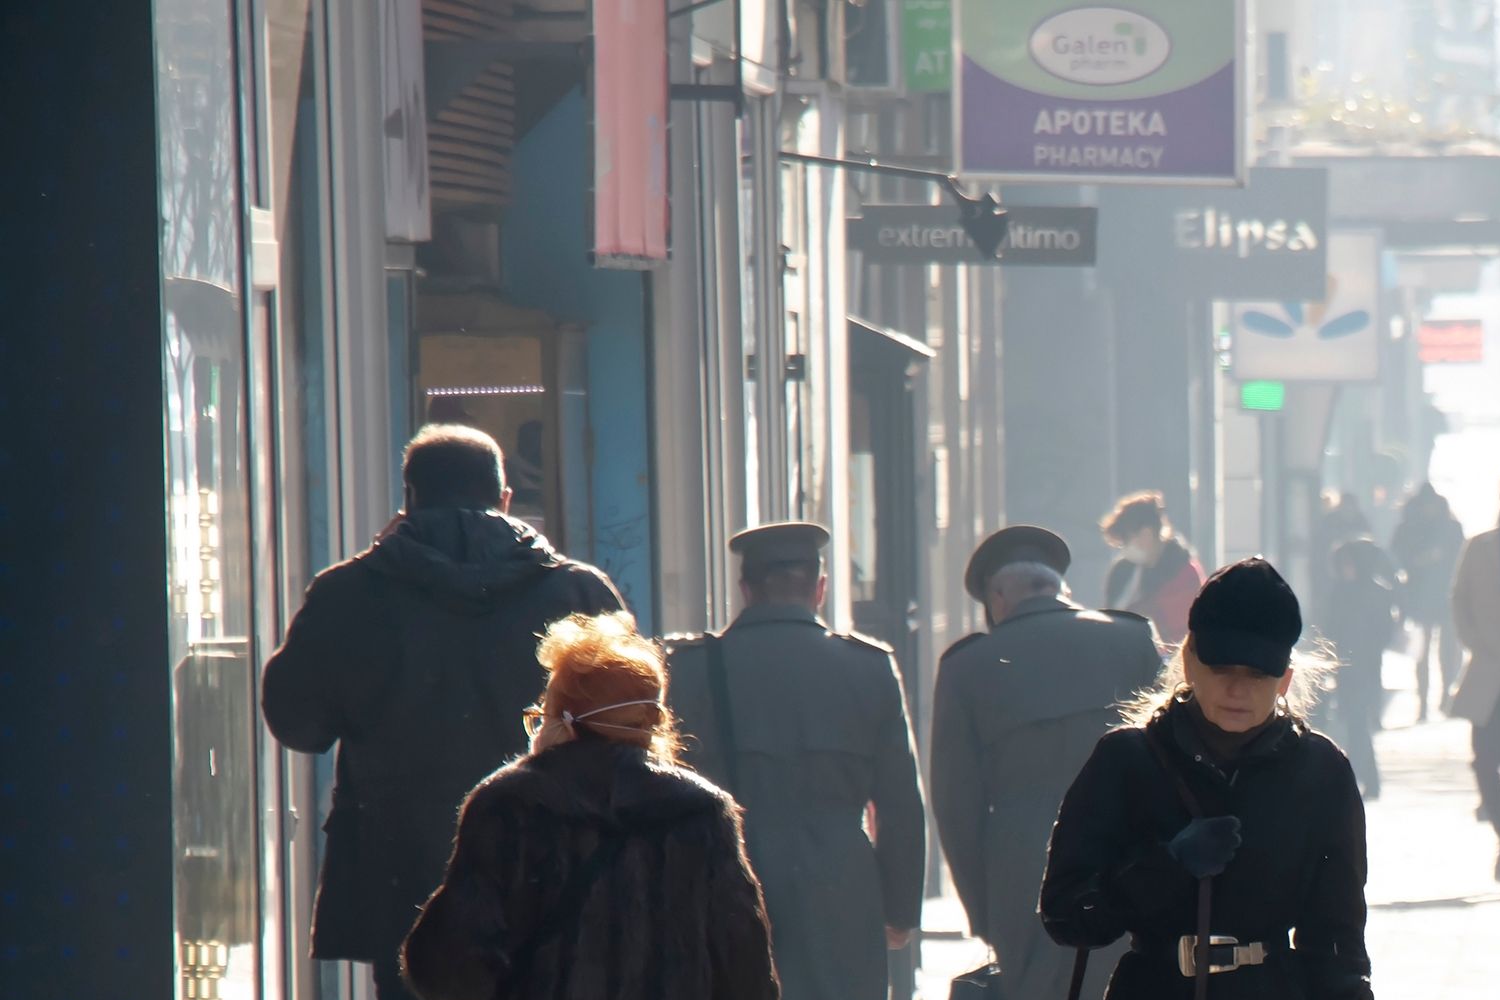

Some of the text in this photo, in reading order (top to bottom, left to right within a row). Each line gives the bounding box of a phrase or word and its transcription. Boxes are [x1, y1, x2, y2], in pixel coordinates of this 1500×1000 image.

[1052, 35, 1128, 55] Galen
[1033, 109, 1168, 136] APOTEKA
[1033, 145, 1164, 168] PHARMACY
[878, 221, 976, 248] extrem
[1174, 207, 1319, 258] Elipsa
